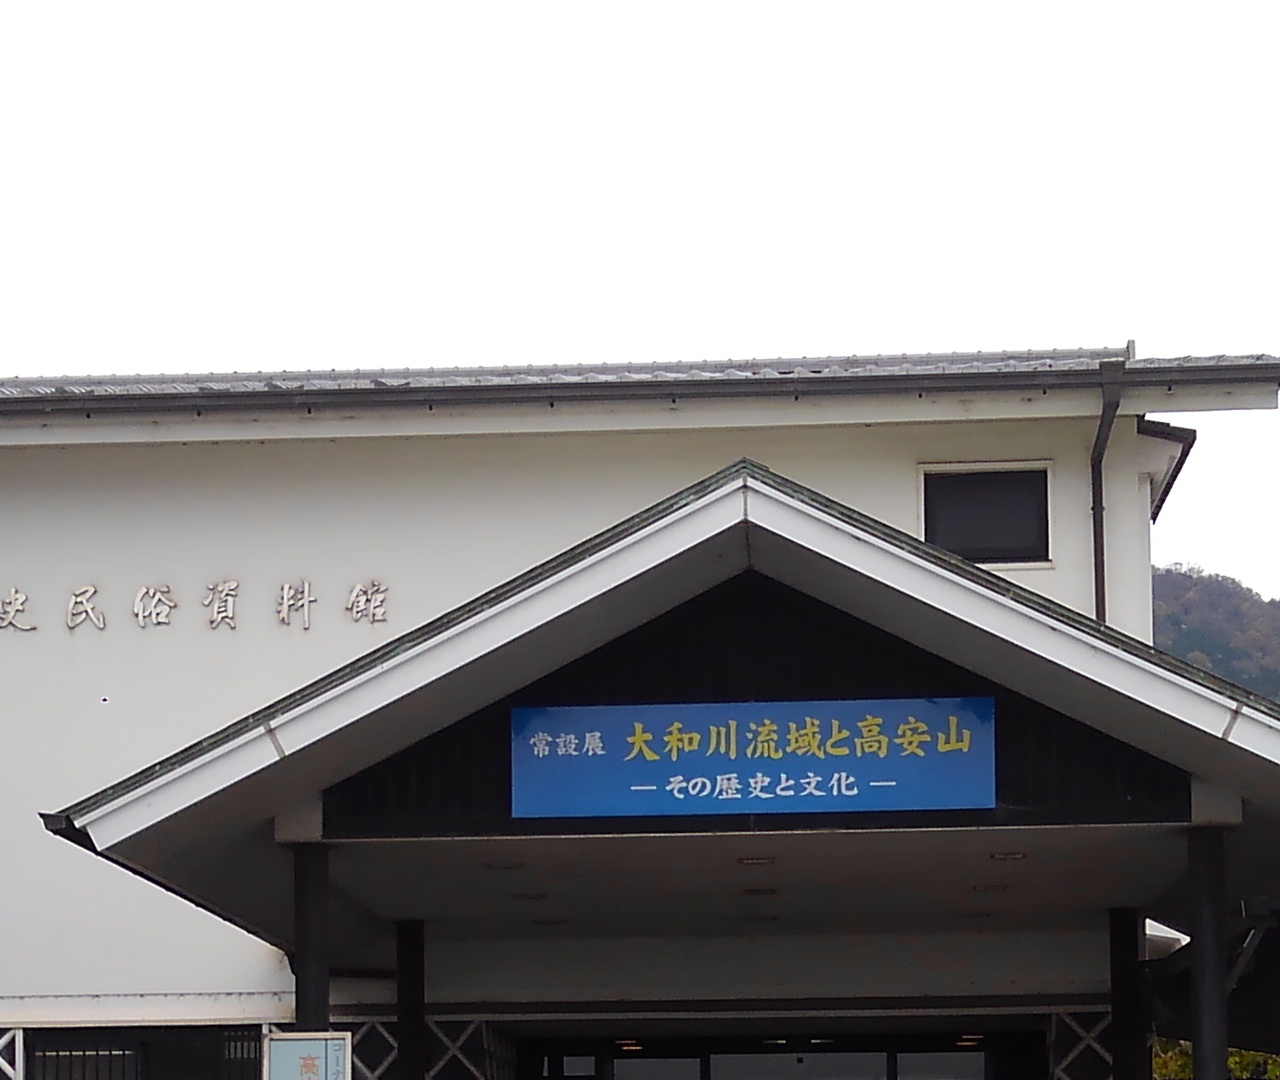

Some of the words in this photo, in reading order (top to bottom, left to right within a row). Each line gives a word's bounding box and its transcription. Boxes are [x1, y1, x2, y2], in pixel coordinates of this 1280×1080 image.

[529, 731, 607, 758] 常設展
[622, 714, 972, 762] 大和川流域と高安山
